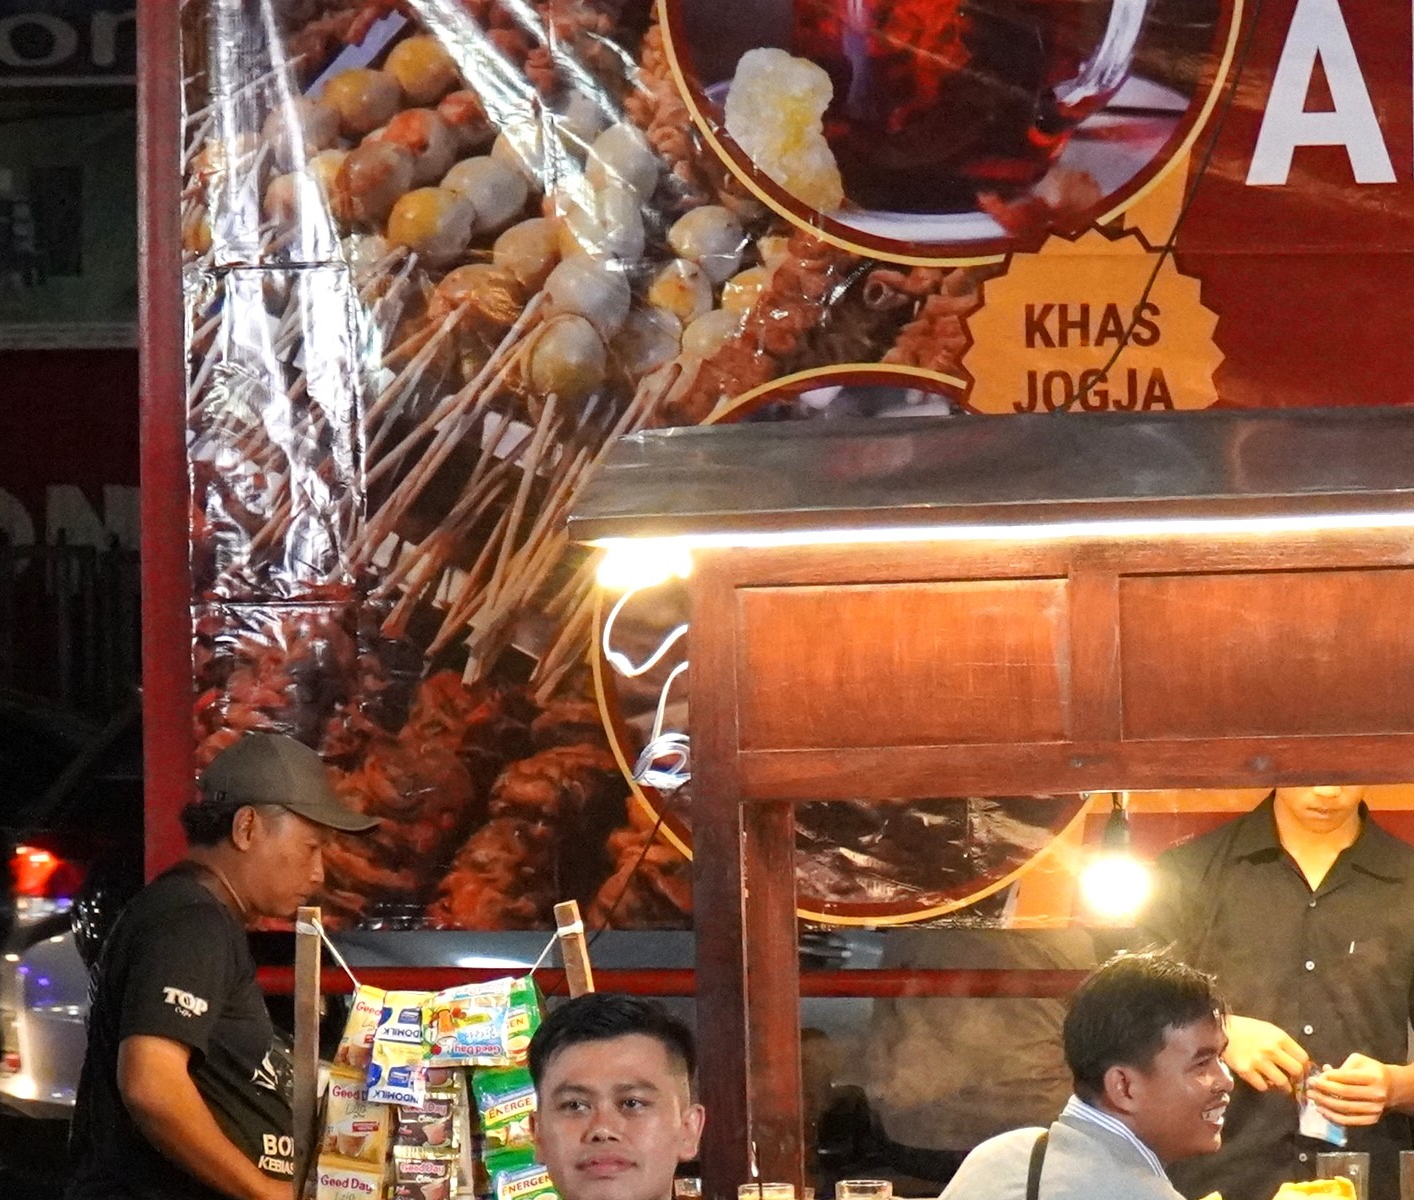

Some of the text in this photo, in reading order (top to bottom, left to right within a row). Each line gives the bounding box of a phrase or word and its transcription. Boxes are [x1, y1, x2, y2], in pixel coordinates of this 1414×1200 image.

[1024, 301, 1162, 349] KHAS
[1012, 367, 1176, 413] JOGJA
[162, 986, 209, 1017] TOP
[488, 1097, 532, 1120] ENERGE
[320, 1174, 374, 1195] Good Day
